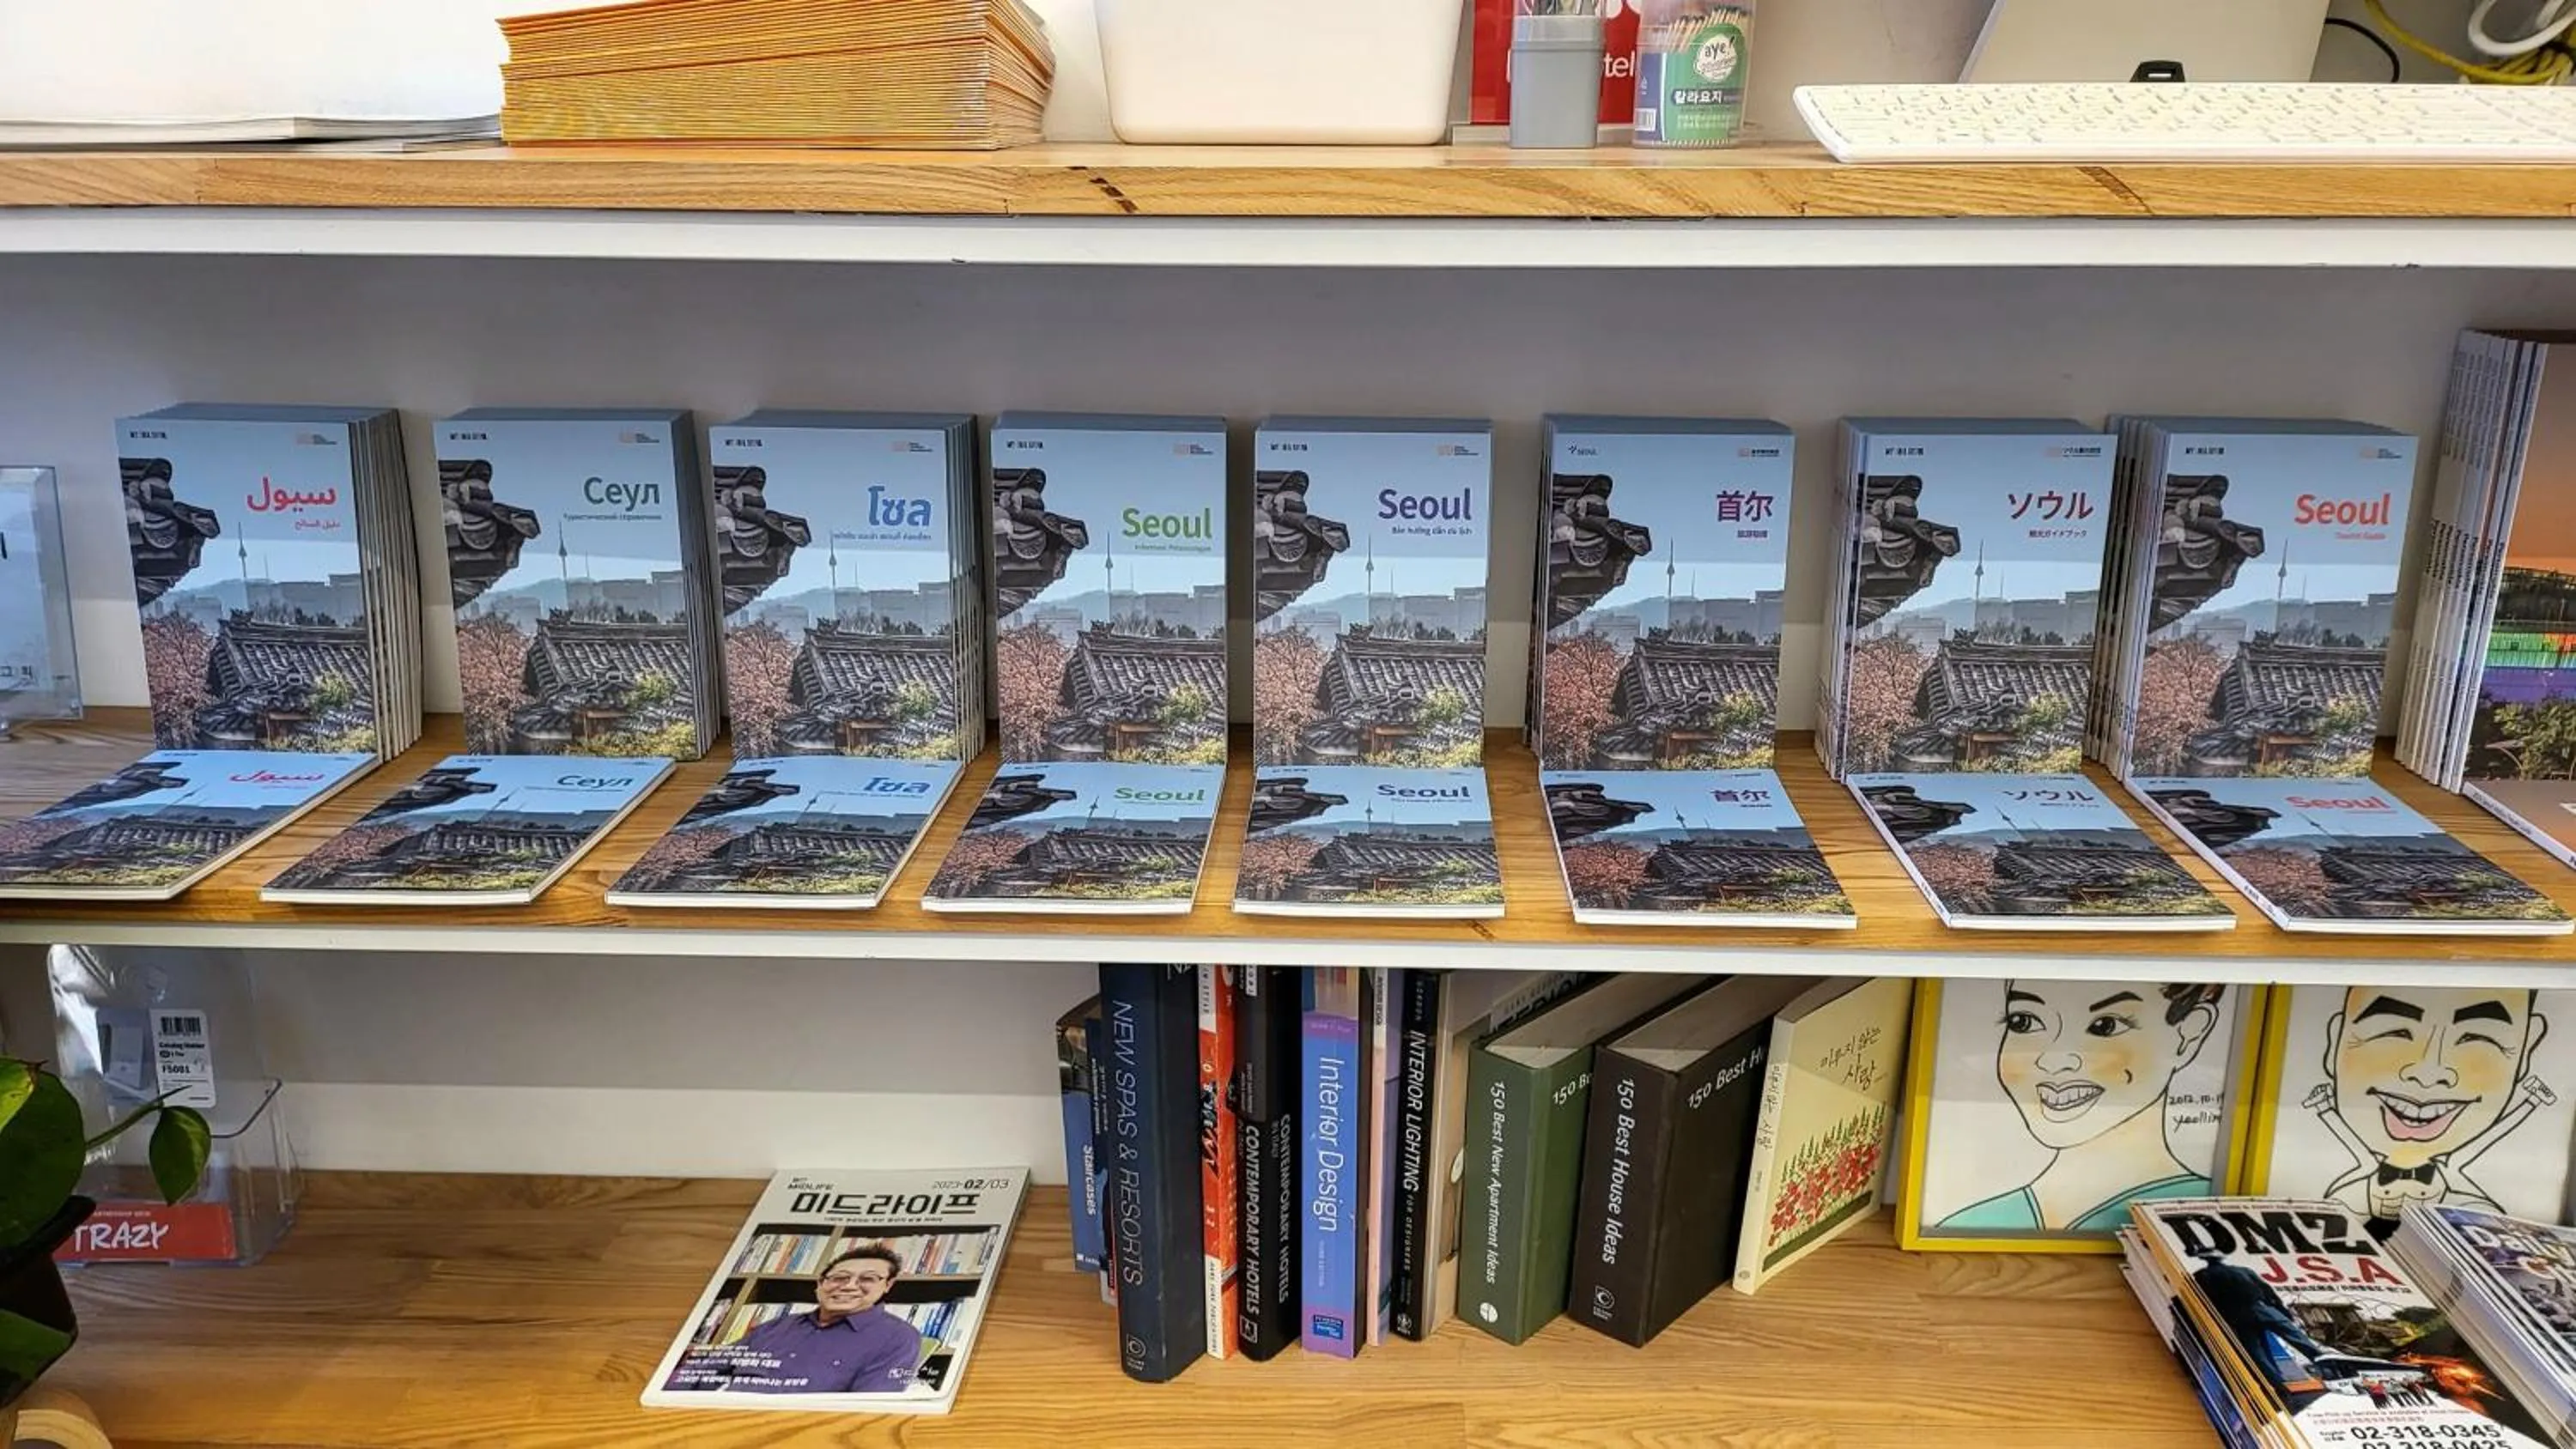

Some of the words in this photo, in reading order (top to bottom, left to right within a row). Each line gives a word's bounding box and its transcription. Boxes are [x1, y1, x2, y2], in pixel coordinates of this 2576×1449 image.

[246, 476, 337, 513] سيول
[583, 476, 660, 512] Сеул
[867, 484, 932, 527] โซล
[1377, 487, 1473, 521] Seoul
[1716, 490, 1774, 523] 首尔
[2008, 490, 2094, 520] ソウル
[2293, 492, 2391, 525] Seoul
[1121, 507, 1213, 539] Seoul
[557, 774, 634, 788] Сеул
[1114, 786, 1206, 801] Seoul
[1376, 784, 1471, 798] Seoul
[2285, 795, 2392, 809] Seoul
[1112, 999, 1137, 1066] NEW
[1406, 1029, 1428, 1111] INTERIOR
[1687, 1082, 1713, 1110] 150
[1716, 1058, 1747, 1090] Best
[1115, 1069, 1138, 1140] SPAS
[1318, 1056, 1346, 1148] Interior
[1490, 1081, 1506, 1109] 150
[1552, 1081, 1577, 1106] 150
[1617, 1078, 1636, 1110] 150
[1491, 1112, 1505, 1140] Best
[1615, 1114, 1636, 1156] Best
[1119, 1144, 1139, 1160] &
[1402, 1113, 1424, 1192] LIGHTING
[1491, 1143, 1504, 1176] New
[1081, 1144, 1097, 1216] Staircases
[1242, 1125, 1261, 1254] CONTEMPORARY
[1279, 1113, 1291, 1242] CONTEMPORARY
[1312, 1149, 1345, 1233] Design
[1607, 1159, 1631, 1216] House
[790, 1191, 981, 1216] 미드라이프
[1486, 1177, 1503, 1247] Apartment
[1117, 1166, 1144, 1287] RESORTS
[1602, 1216, 1624, 1265] Ideas
[2157, 1211, 2380, 1257] DMZ
[1277, 1245, 1290, 1304] HOTELS
[1485, 1246, 1501, 1284] Ideas
[2258, 1256, 2406, 1285] J.S.A
[1241, 1257, 1260, 1316] HOTELS
[2350, 1424, 2502, 1440] 02-318-0345
